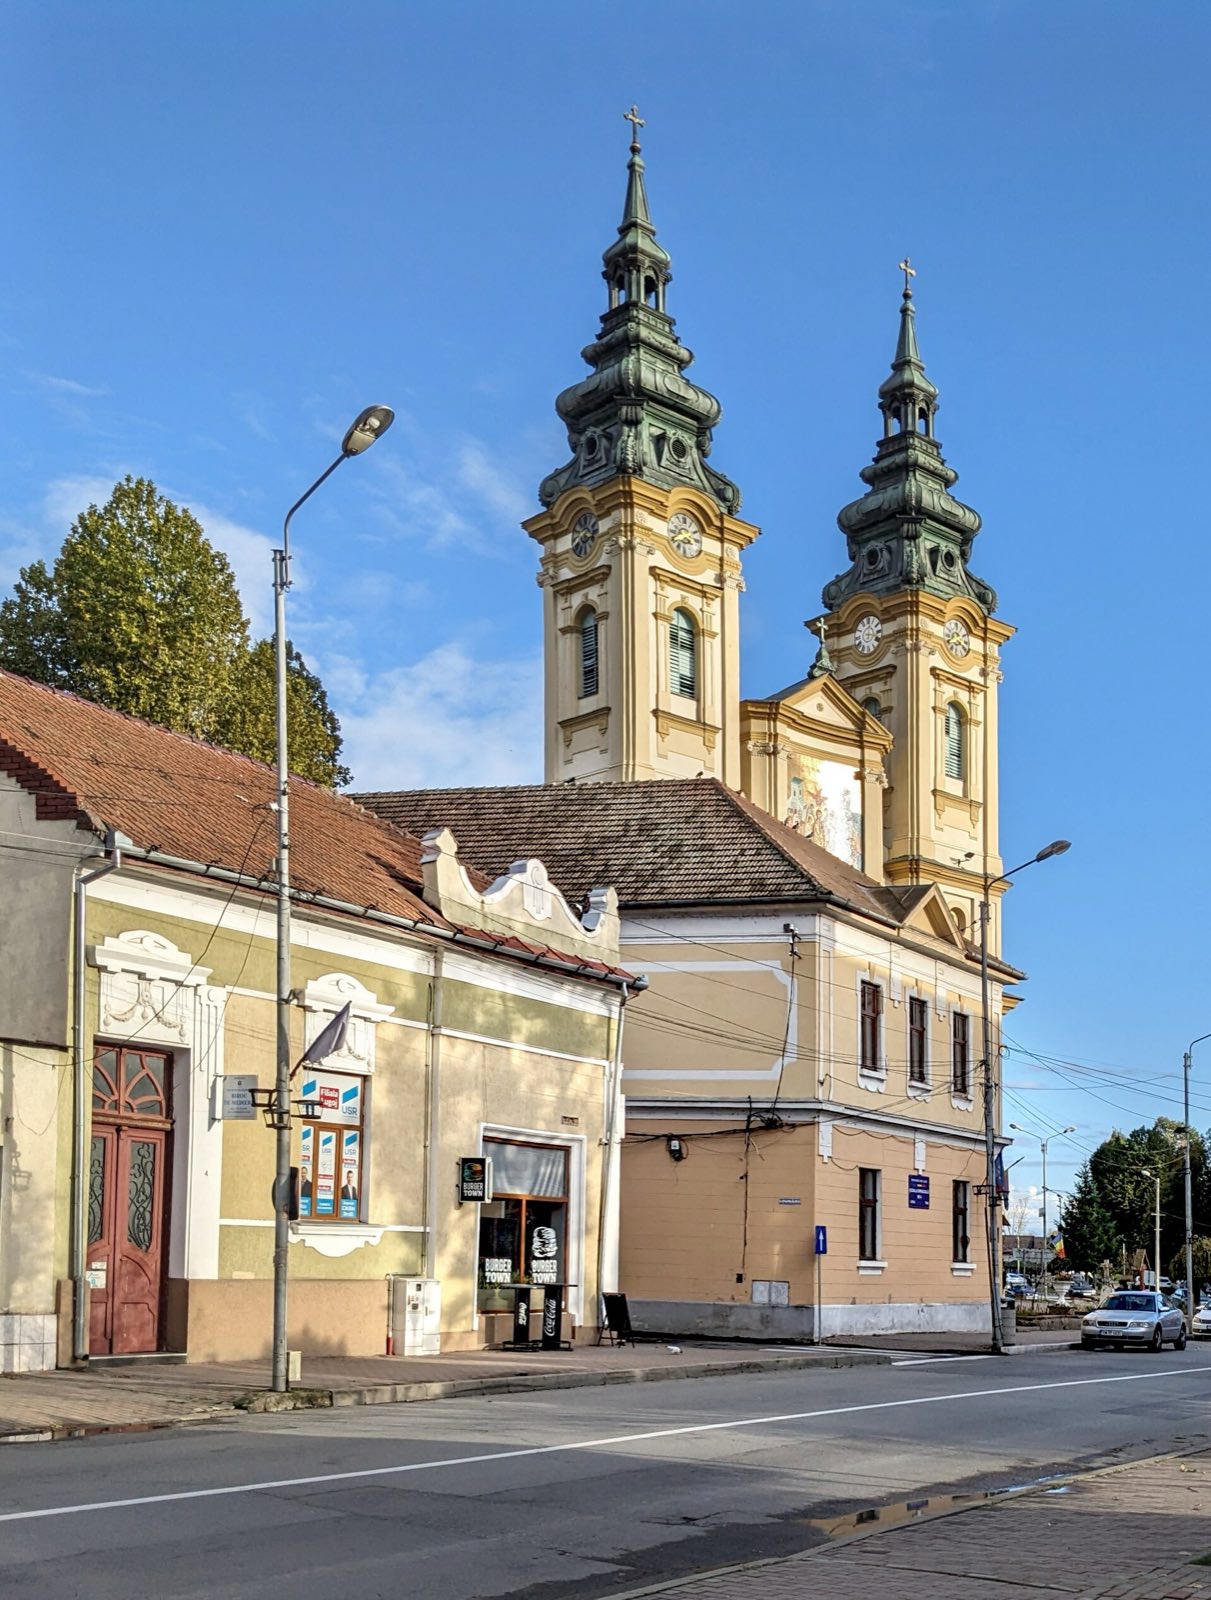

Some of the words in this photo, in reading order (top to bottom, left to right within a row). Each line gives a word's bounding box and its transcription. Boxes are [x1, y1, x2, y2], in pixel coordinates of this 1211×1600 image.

[341, 1106, 358, 1116] USR
[463, 1182, 484, 1190] BURGER
[485, 1258, 512, 1272] BURGER
[531, 1259, 558, 1273] BURGER
[484, 1271, 511, 1283] TOWN
[531, 1272, 557, 1283] TOWN
